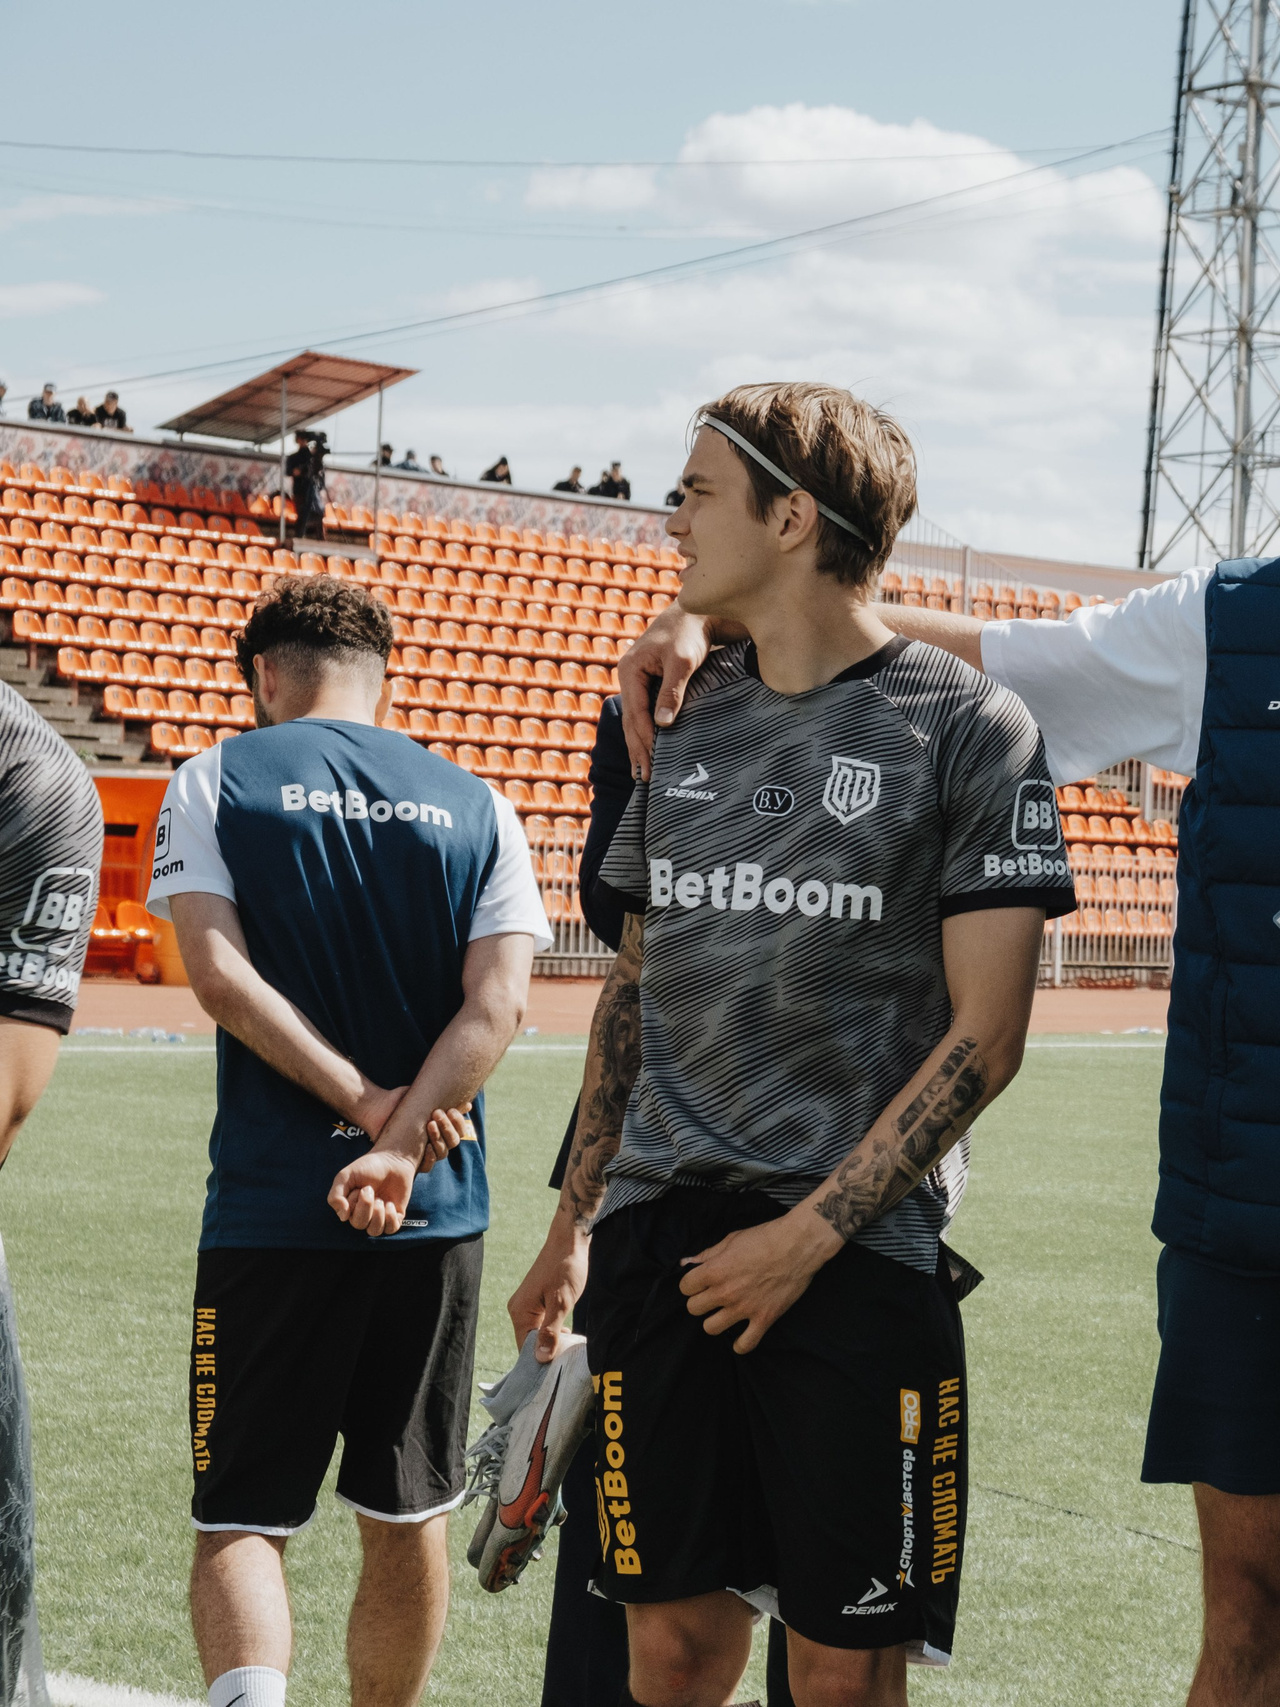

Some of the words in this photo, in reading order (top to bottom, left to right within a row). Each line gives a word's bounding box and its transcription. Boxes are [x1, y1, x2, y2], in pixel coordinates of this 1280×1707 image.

[281, 783, 453, 829] BetBoom
[664, 787, 719, 801] DEMIX
[1023, 800, 1053, 830] BB
[156, 824, 166, 848] B
[983, 853, 1071, 877] BetBoo
[650, 859, 883, 922] BetBoom
[35, 892, 84, 931] BB
[196, 1308, 216, 1346] НАС
[195, 1353, 216, 1377] НЕ
[903, 1392, 919, 1440] PRO
[938, 1377, 960, 1429] НАС
[194, 1383, 217, 1472] СЛОМАТЬ
[933, 1433, 959, 1466] НЕ
[603, 1371, 642, 1575] BetBoom
[931, 1471, 958, 1585] СЛОМАТЬ
[842, 1602, 899, 1616] DEMIX
